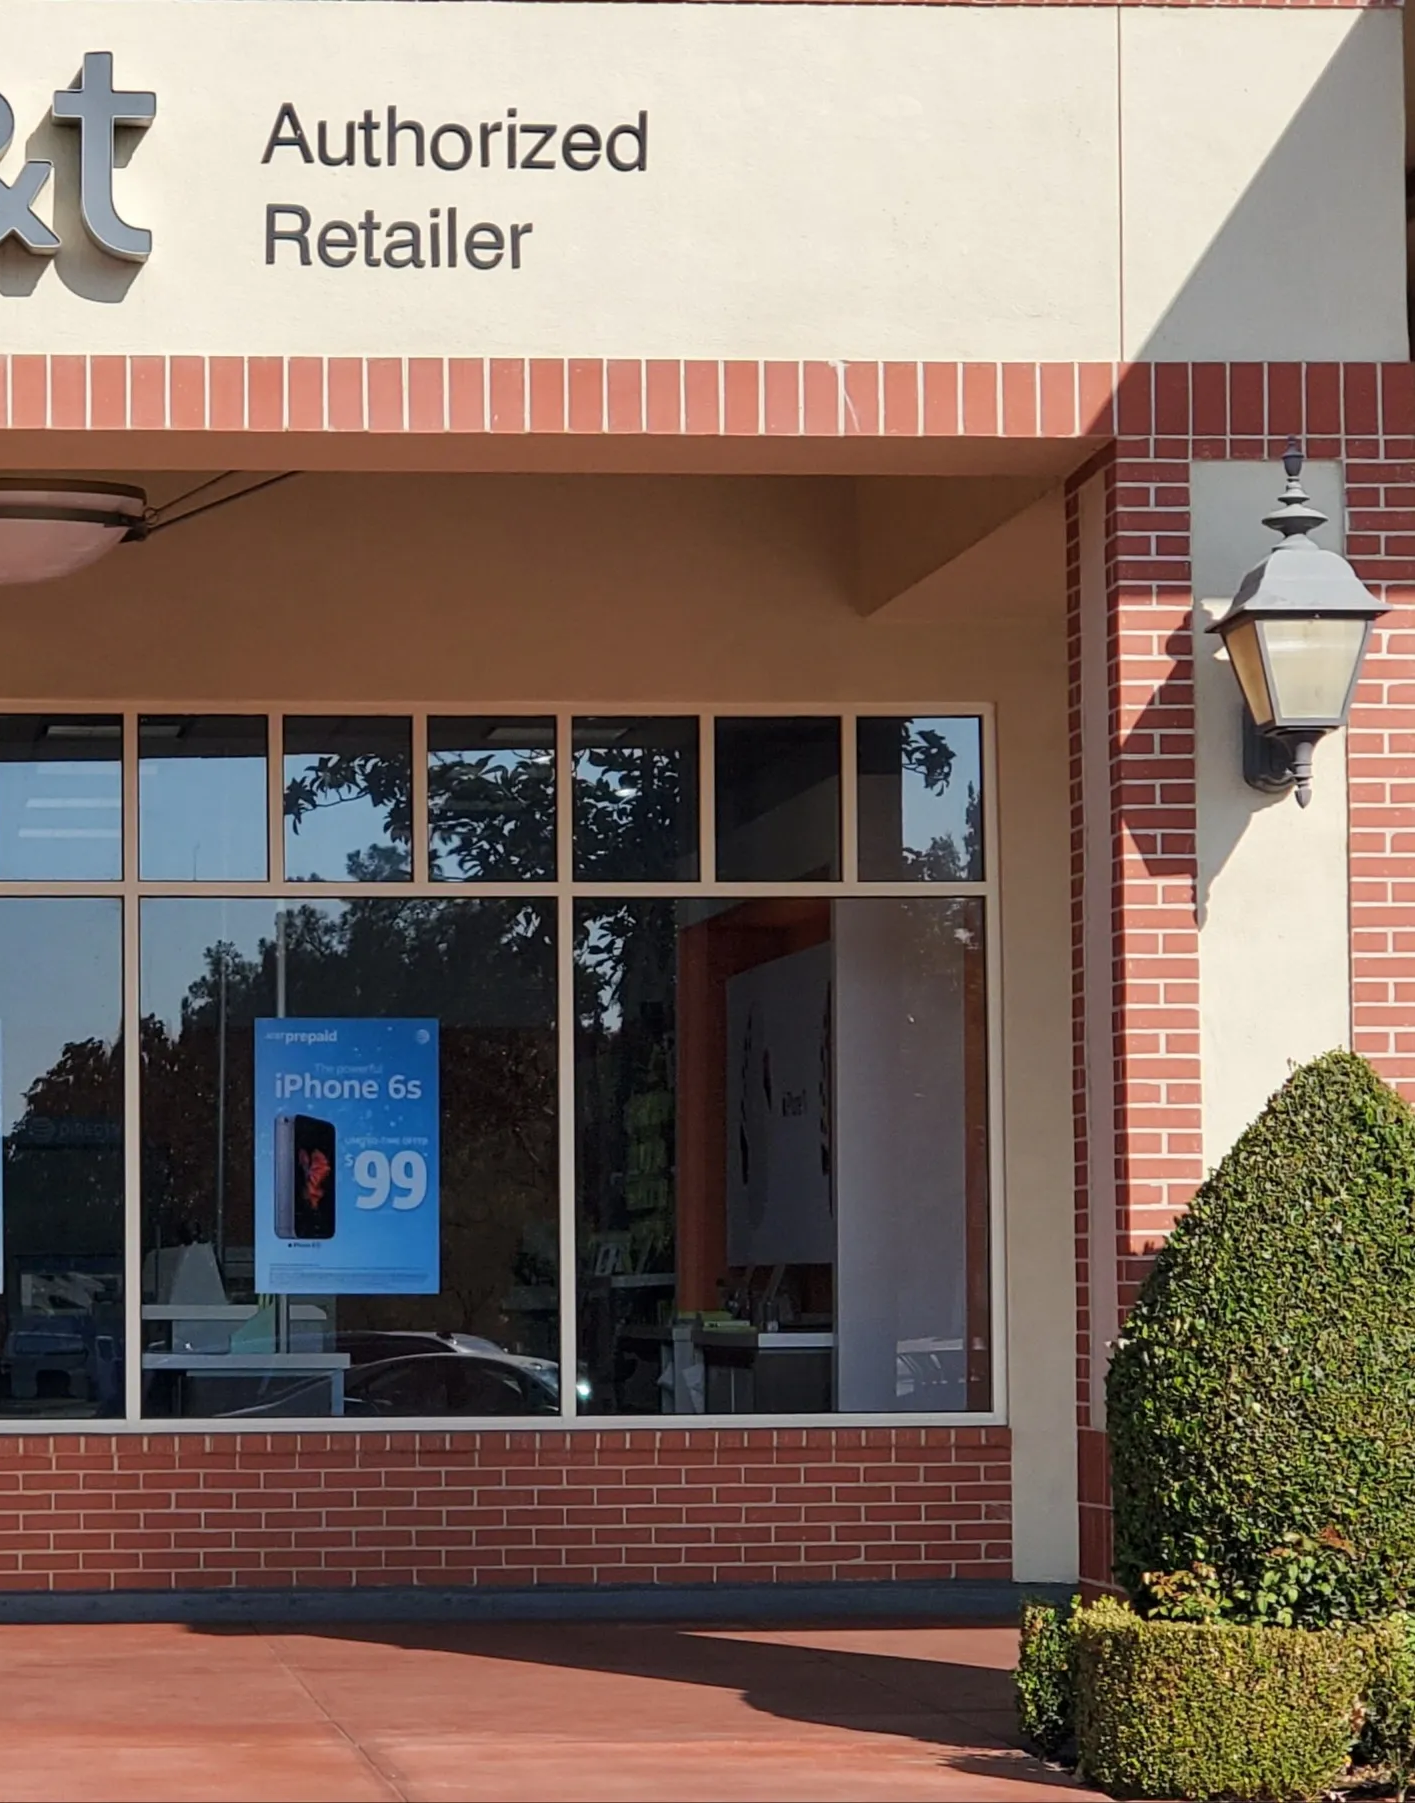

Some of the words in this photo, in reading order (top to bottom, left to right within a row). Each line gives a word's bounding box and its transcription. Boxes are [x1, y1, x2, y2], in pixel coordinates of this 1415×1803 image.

[261, 102, 648, 172] Authorized
[265, 203, 534, 270] Retailer
[285, 1029, 338, 1045] prepaid
[336, 1063, 384, 1076] powerful
[274, 1072, 380, 1099] iPhone
[388, 1074, 423, 1100] 6s
